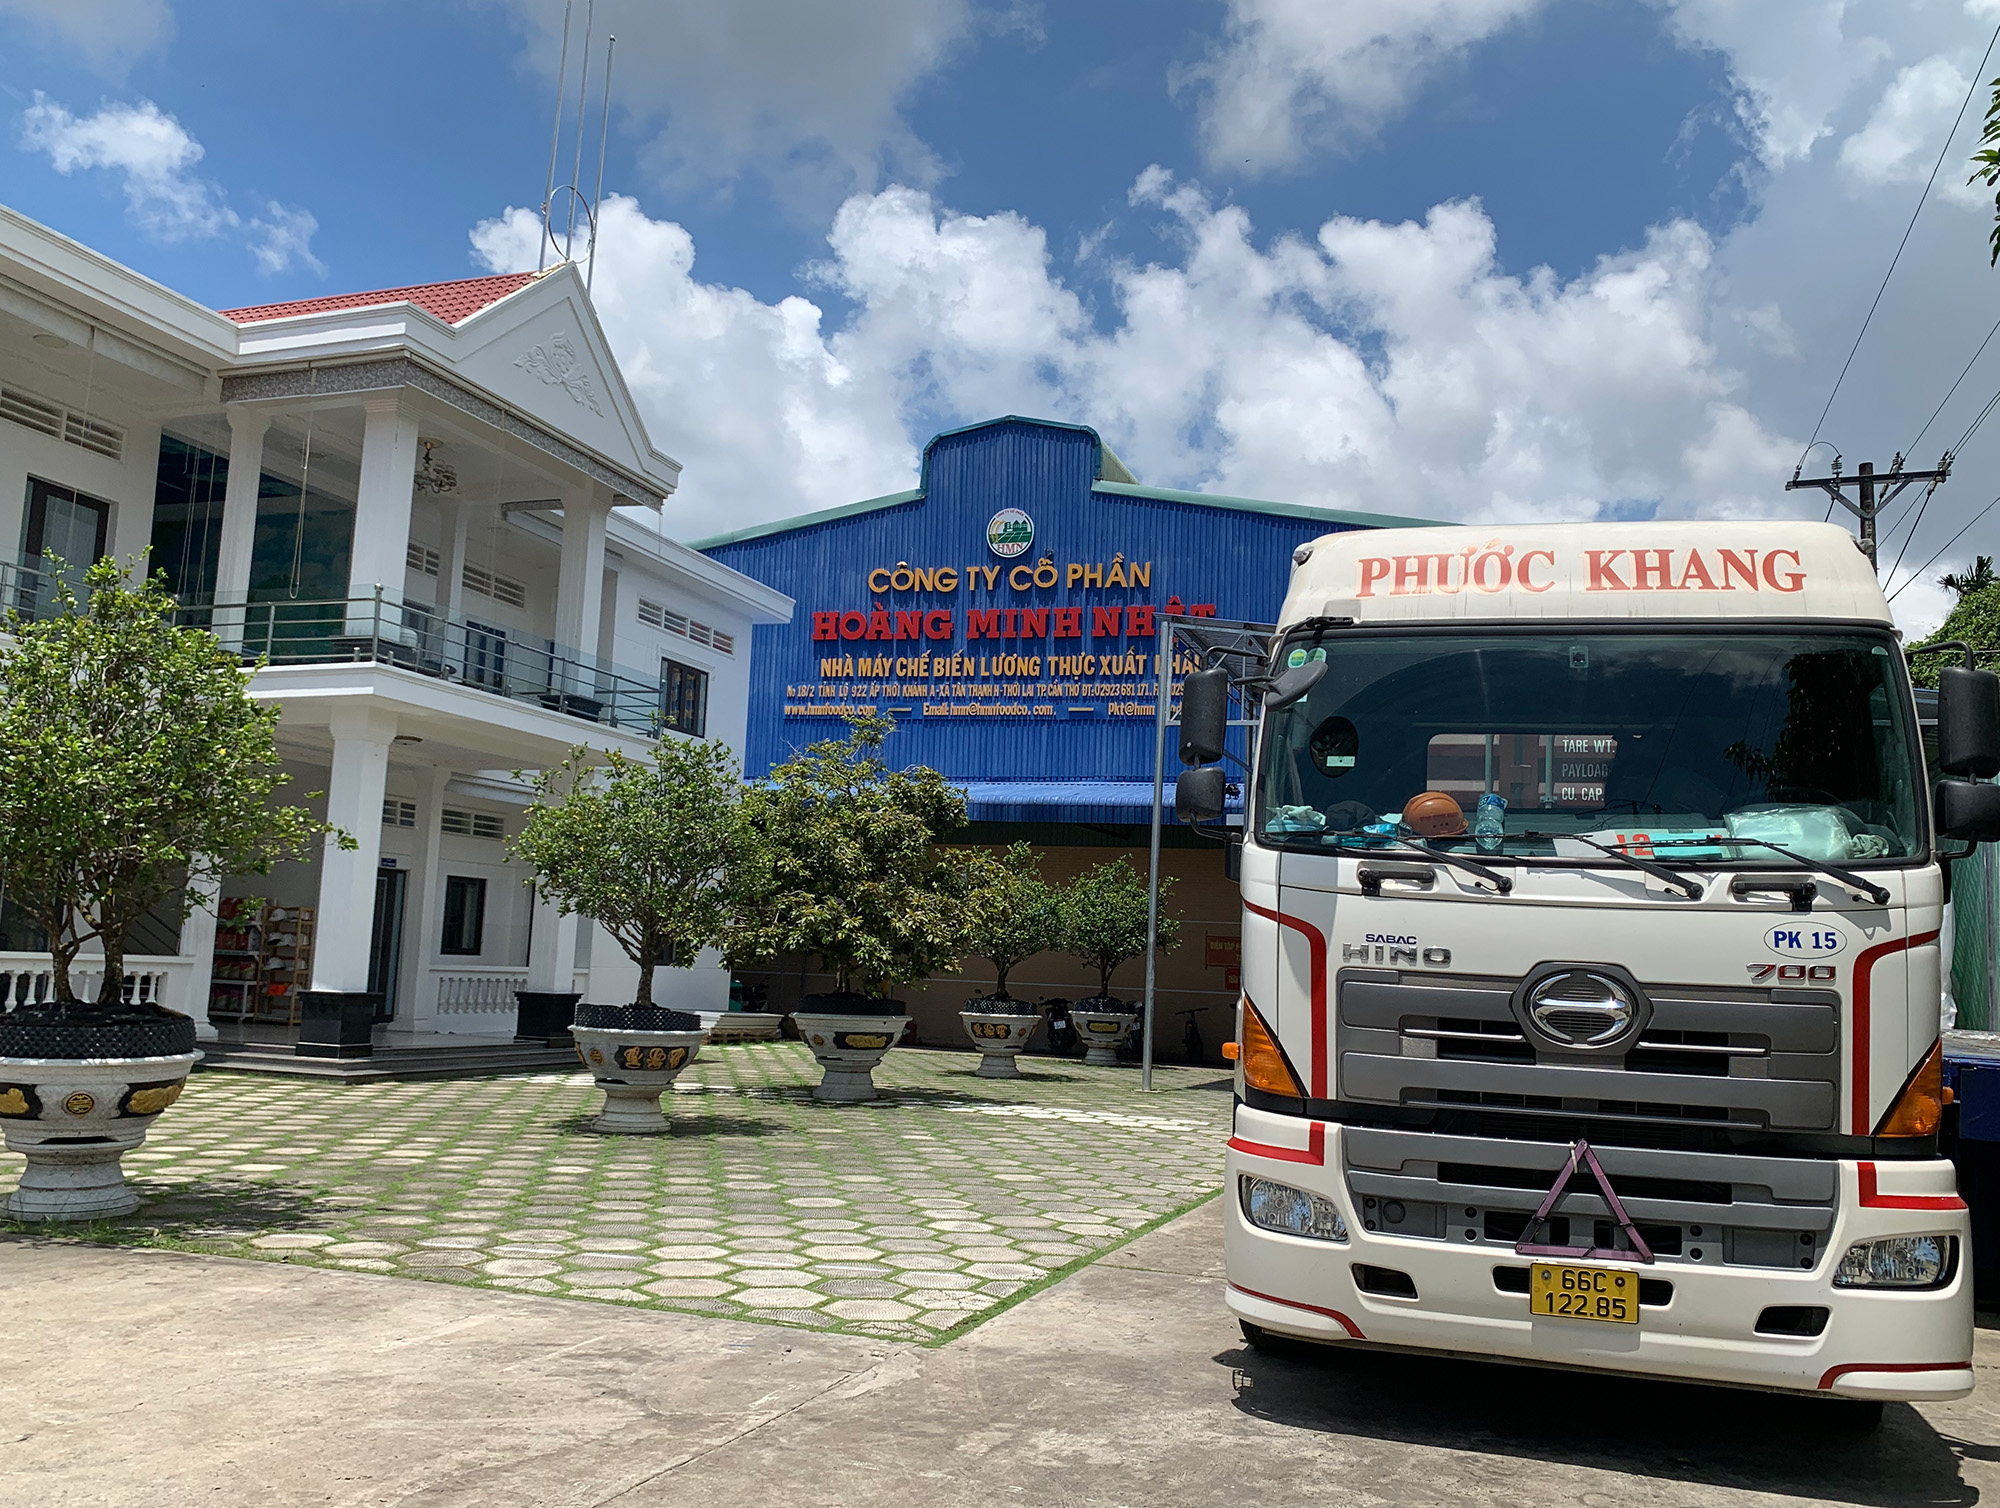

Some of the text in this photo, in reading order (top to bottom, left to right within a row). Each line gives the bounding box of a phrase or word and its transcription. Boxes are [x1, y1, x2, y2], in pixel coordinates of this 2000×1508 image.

[997, 542, 1024, 555] HMN
[868, 561, 958, 593] CÔNG
[966, 565, 1000, 591] TY
[1067, 552, 1151, 588] PHẦN
[1355, 538, 1808, 597] PHƯỚC KHANG
[812, 602, 954, 640] HOÀNG
[966, 607, 1082, 639] MINH
[821, 653, 854, 677] NHÀ
[857, 653, 893, 677] MÁY
[896, 649, 931, 677] CHẾ
[933, 649, 975, 677] BIẾN
[1048, 651, 1095, 680] THỰC
[1099, 646, 1147, 676] XUẤT
[797, 684, 815, 697] 18/2
[851, 685, 867, 697] 922
[1121, 683, 1135, 696] 681
[1562, 739, 1615, 753] TARE WT.
[1562, 763, 1608, 778] PAYLOAD
[1561, 786, 1605, 801] CU. CAP.
[1365, 933, 1418, 945] SABAC
[1773, 931, 1837, 950] PK 15
[1342, 942, 1452, 969] HINO
[1746, 962, 1836, 987] 700
[1561, 1268, 1607, 1293] 66C
[1545, 1291, 1627, 1320] 122.85
